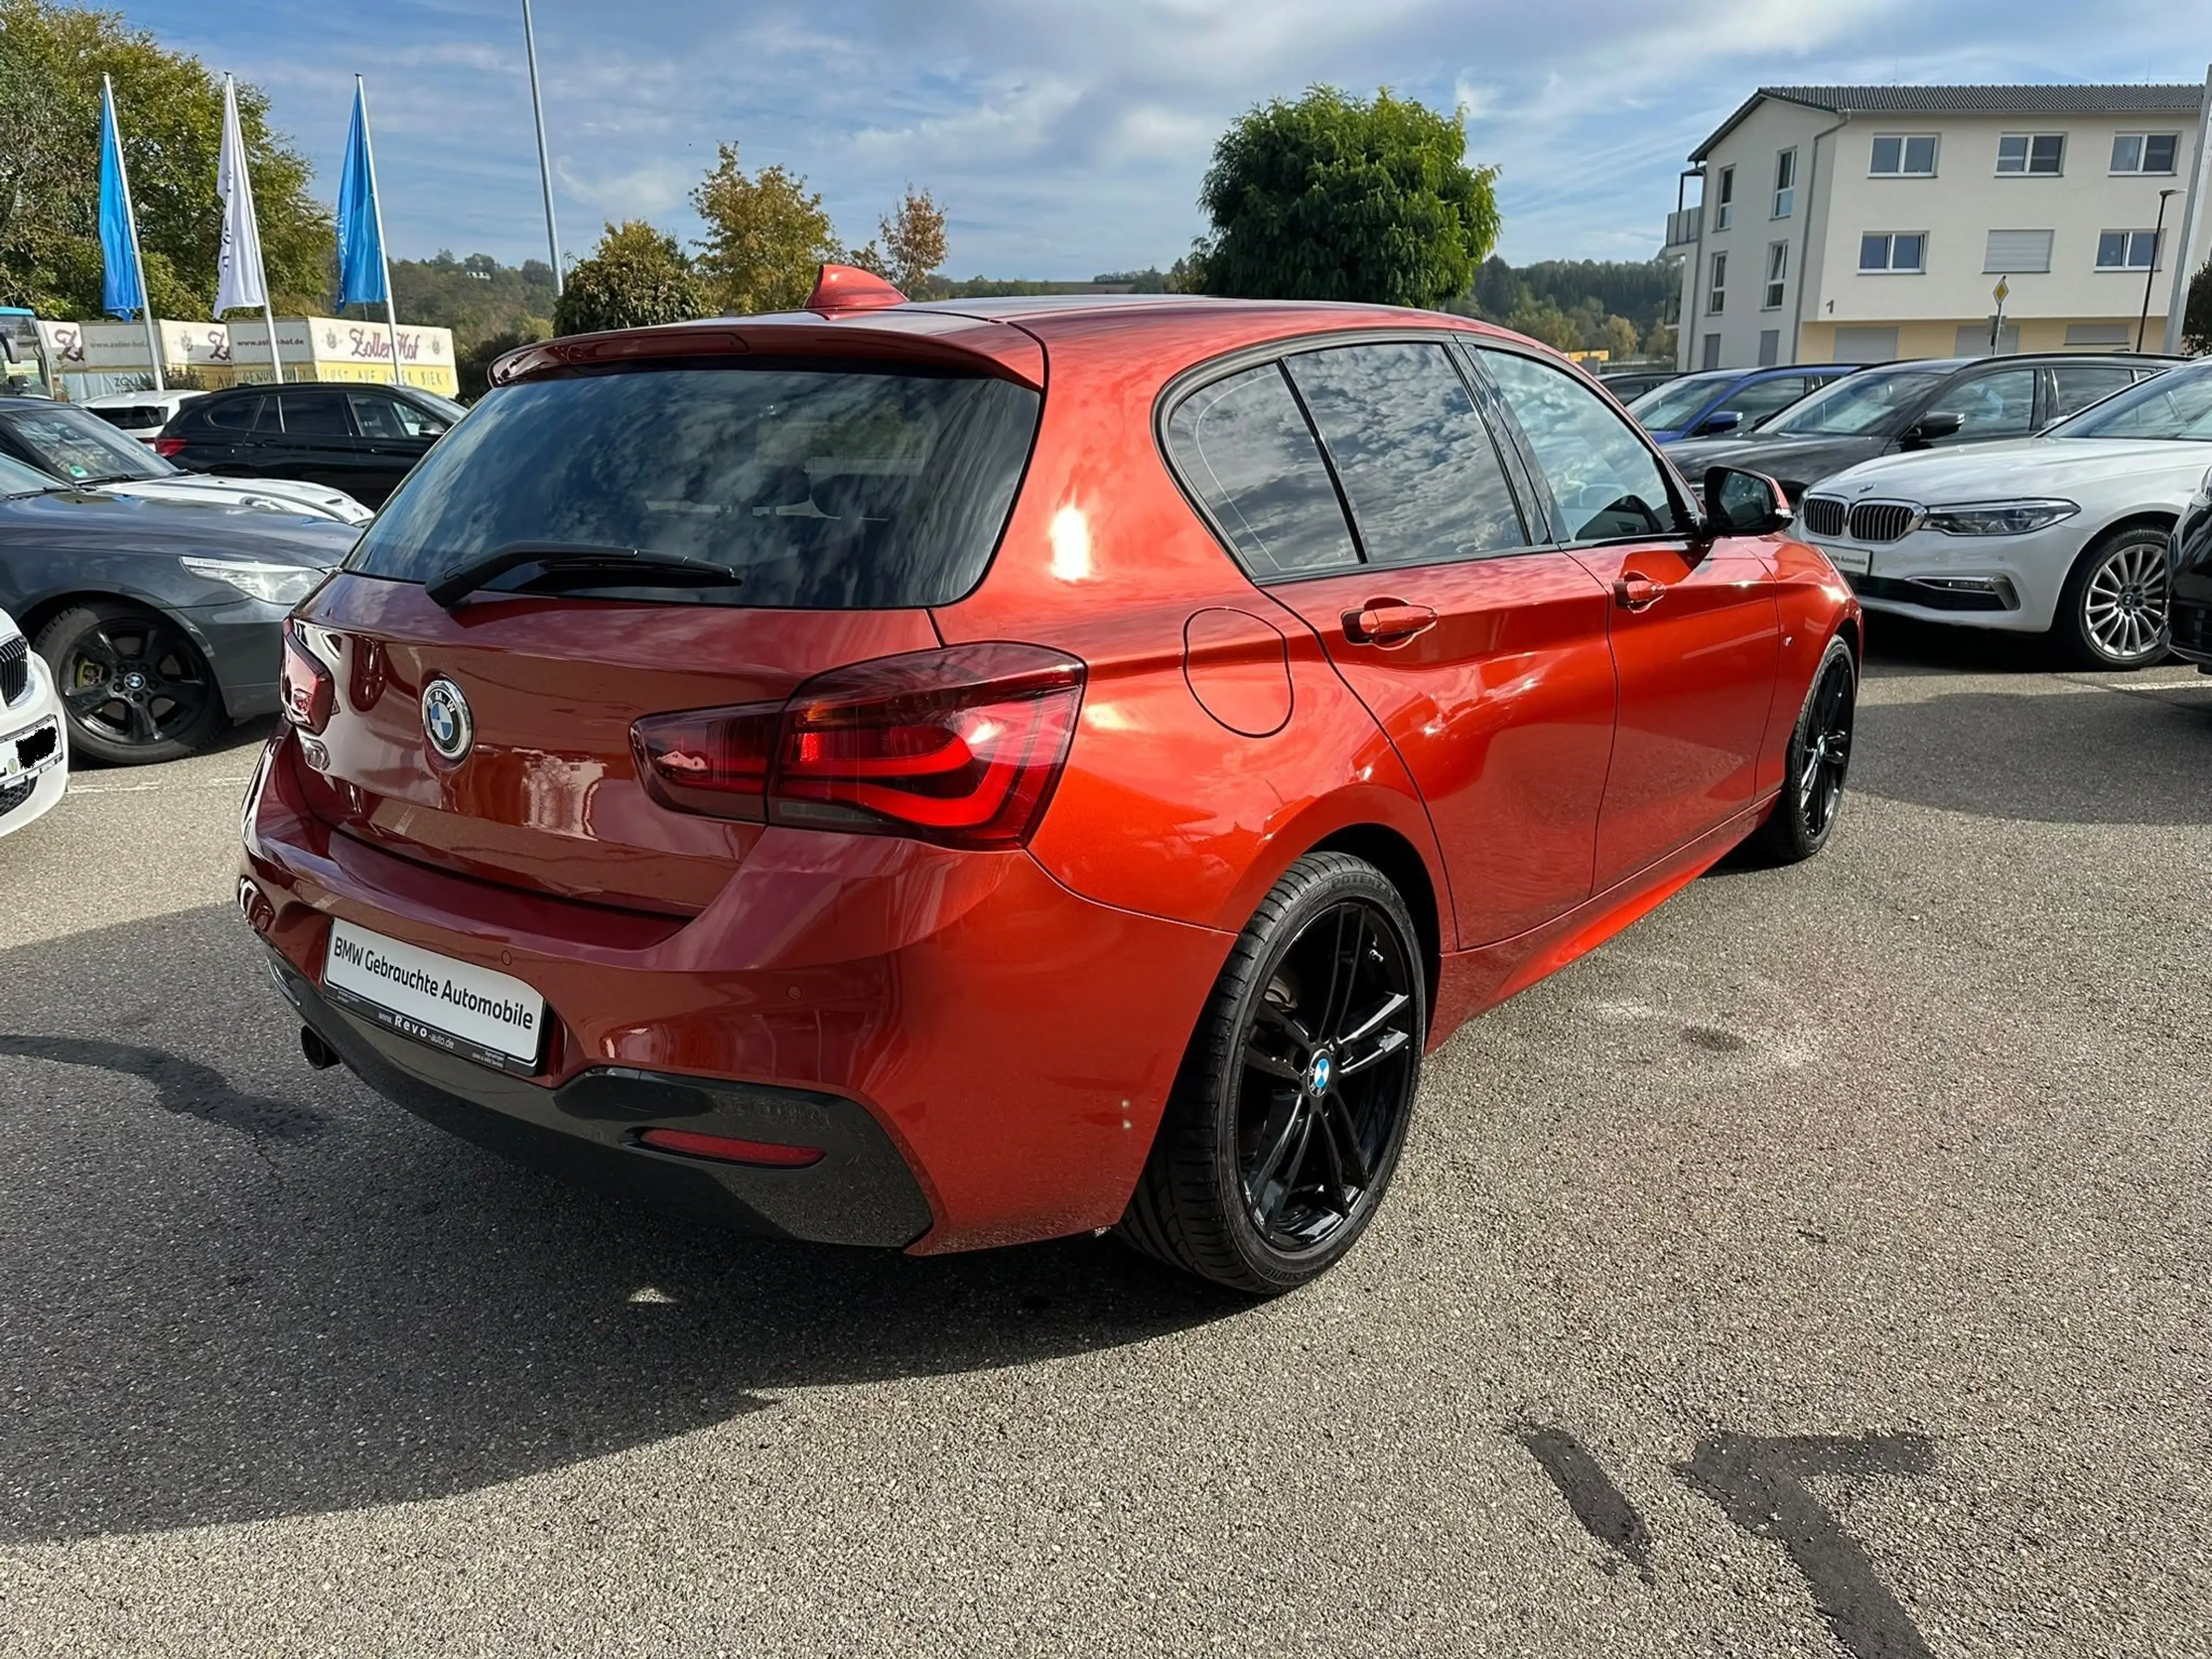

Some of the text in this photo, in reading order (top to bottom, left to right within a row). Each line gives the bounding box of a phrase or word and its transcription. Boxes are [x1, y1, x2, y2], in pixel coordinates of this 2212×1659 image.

[1826, 300, 1834, 314] 1
[243, 370, 276, 382] GENUS
[383, 371, 414, 386] UNER
[334, 936, 533, 1030] BMW Gebrauchte Automobile
